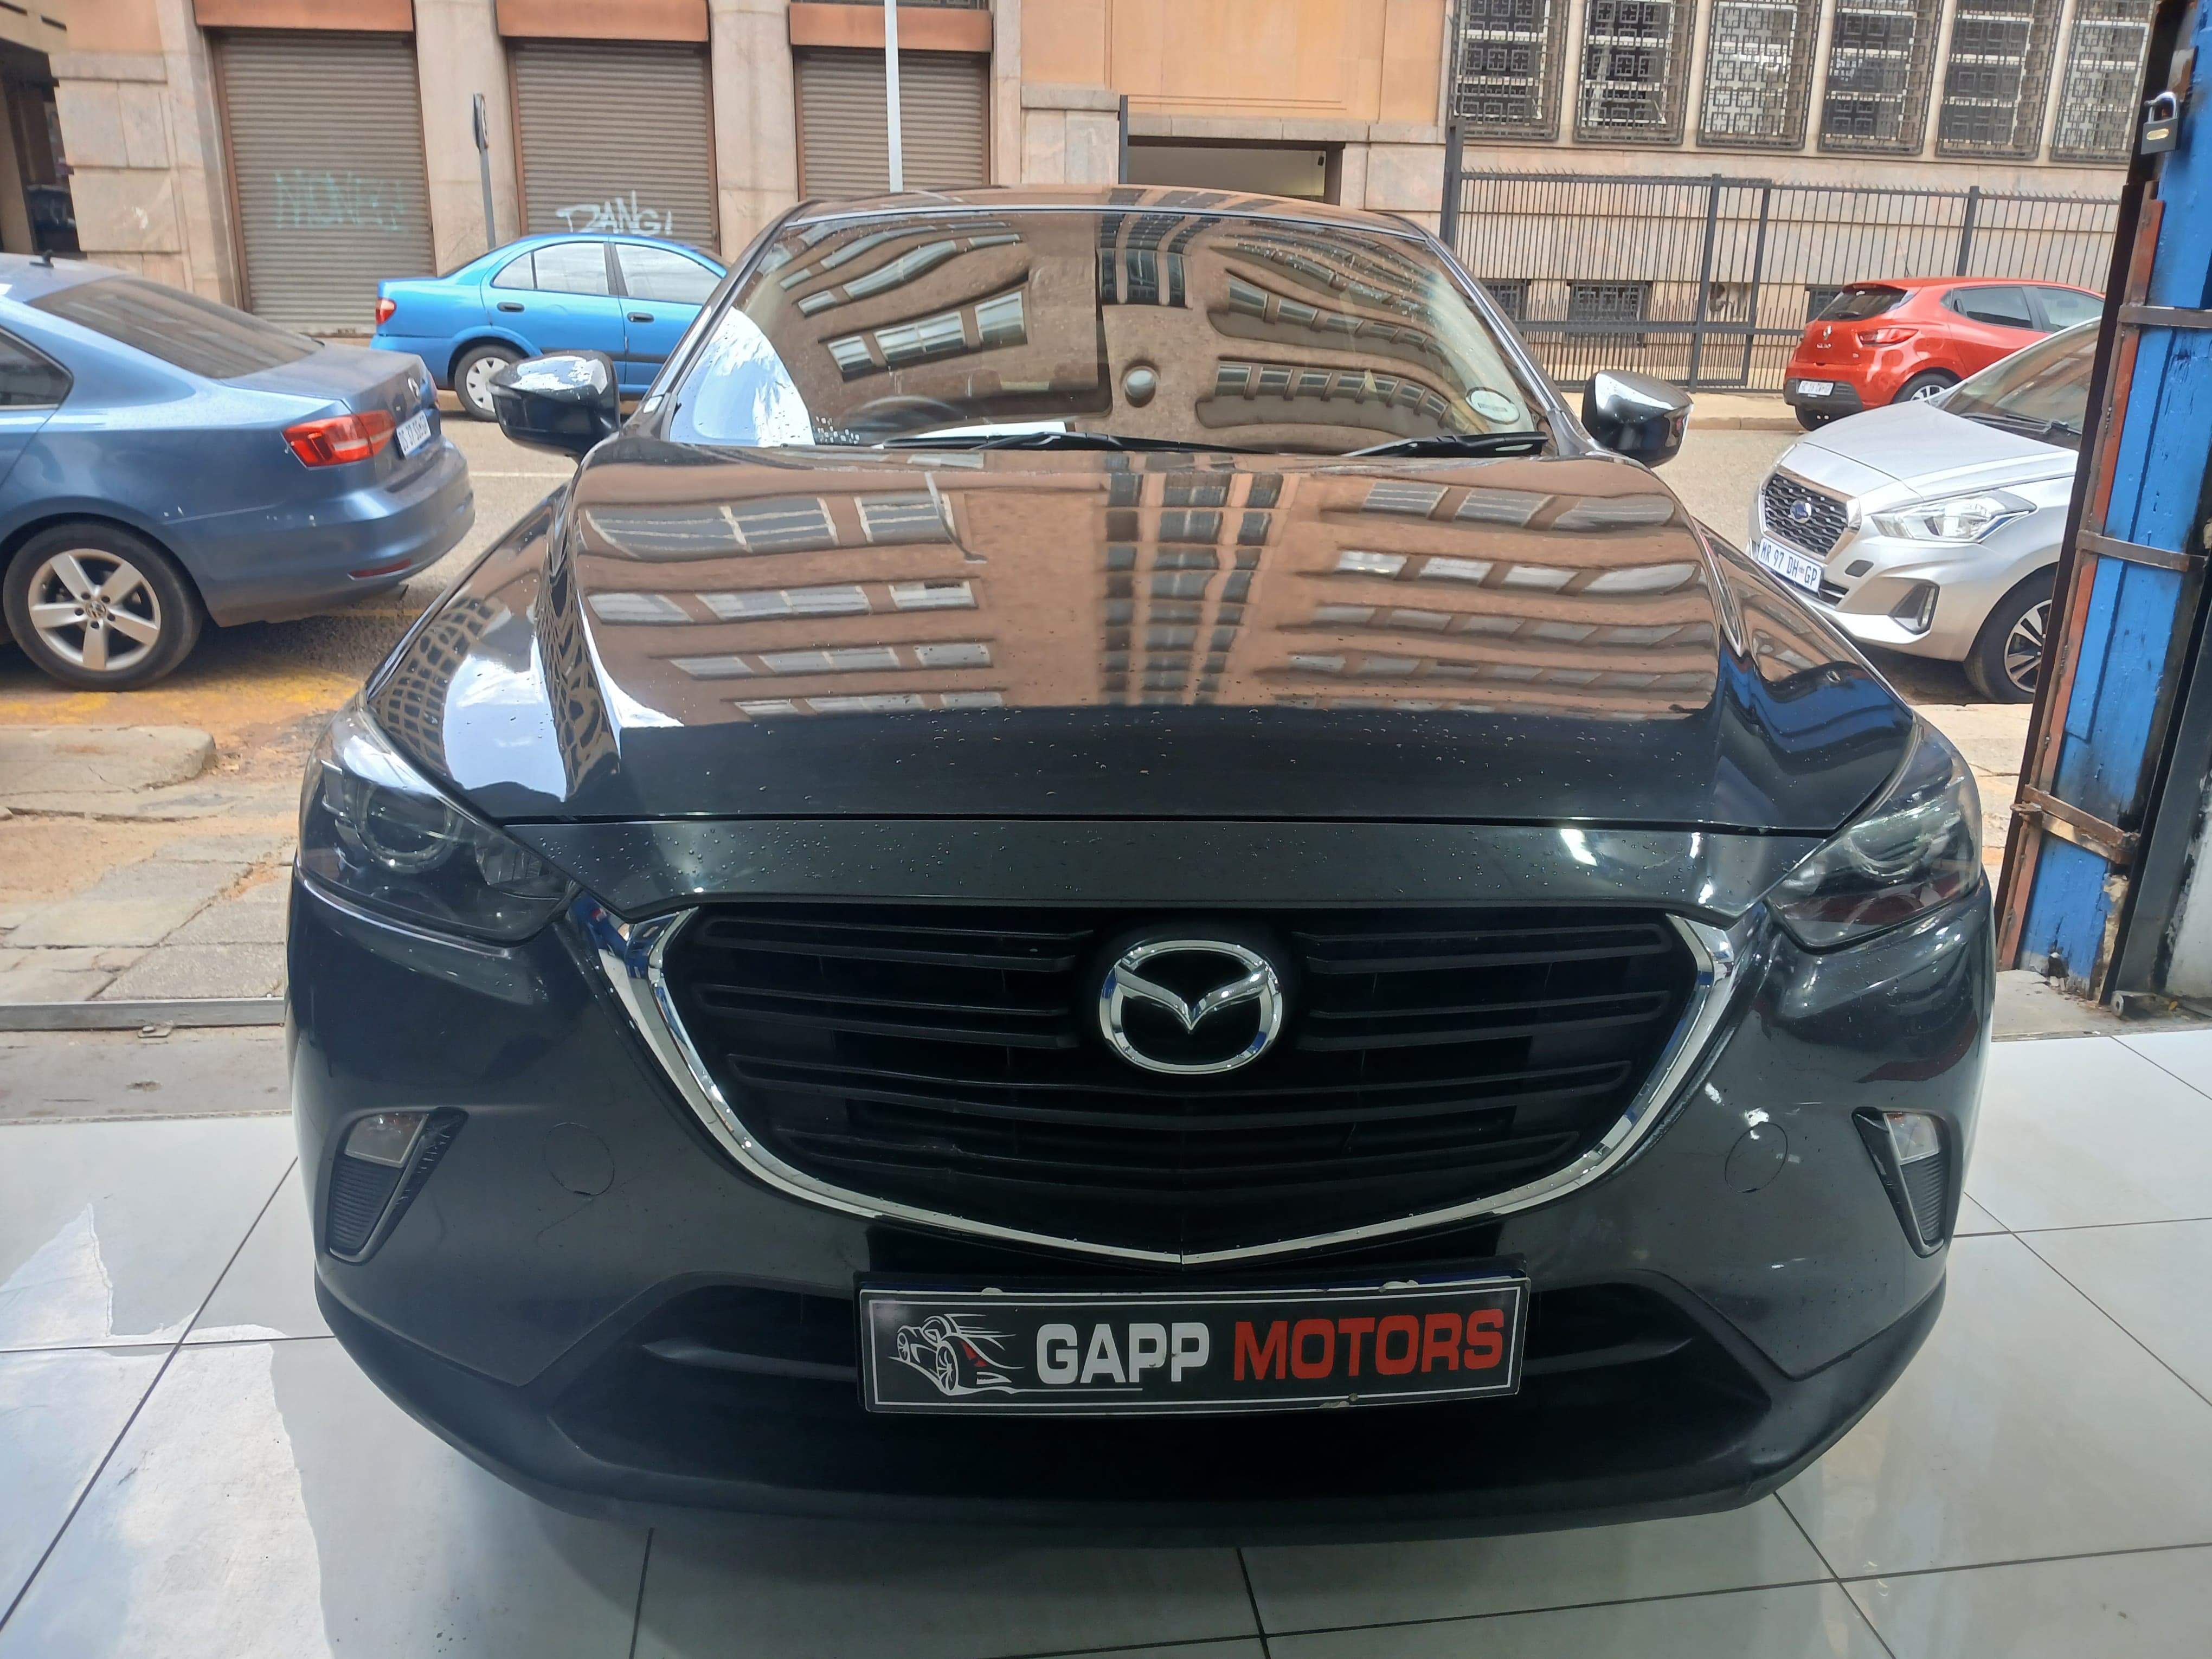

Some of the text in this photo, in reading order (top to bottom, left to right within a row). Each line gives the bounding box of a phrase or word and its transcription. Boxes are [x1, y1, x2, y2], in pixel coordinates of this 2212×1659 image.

[1774, 549, 1784, 569] 97
[1786, 555, 1799, 578] DH
[1804, 565, 1817, 586] GP
[1036, 1309, 1504, 1385] GAPP MOTORS
